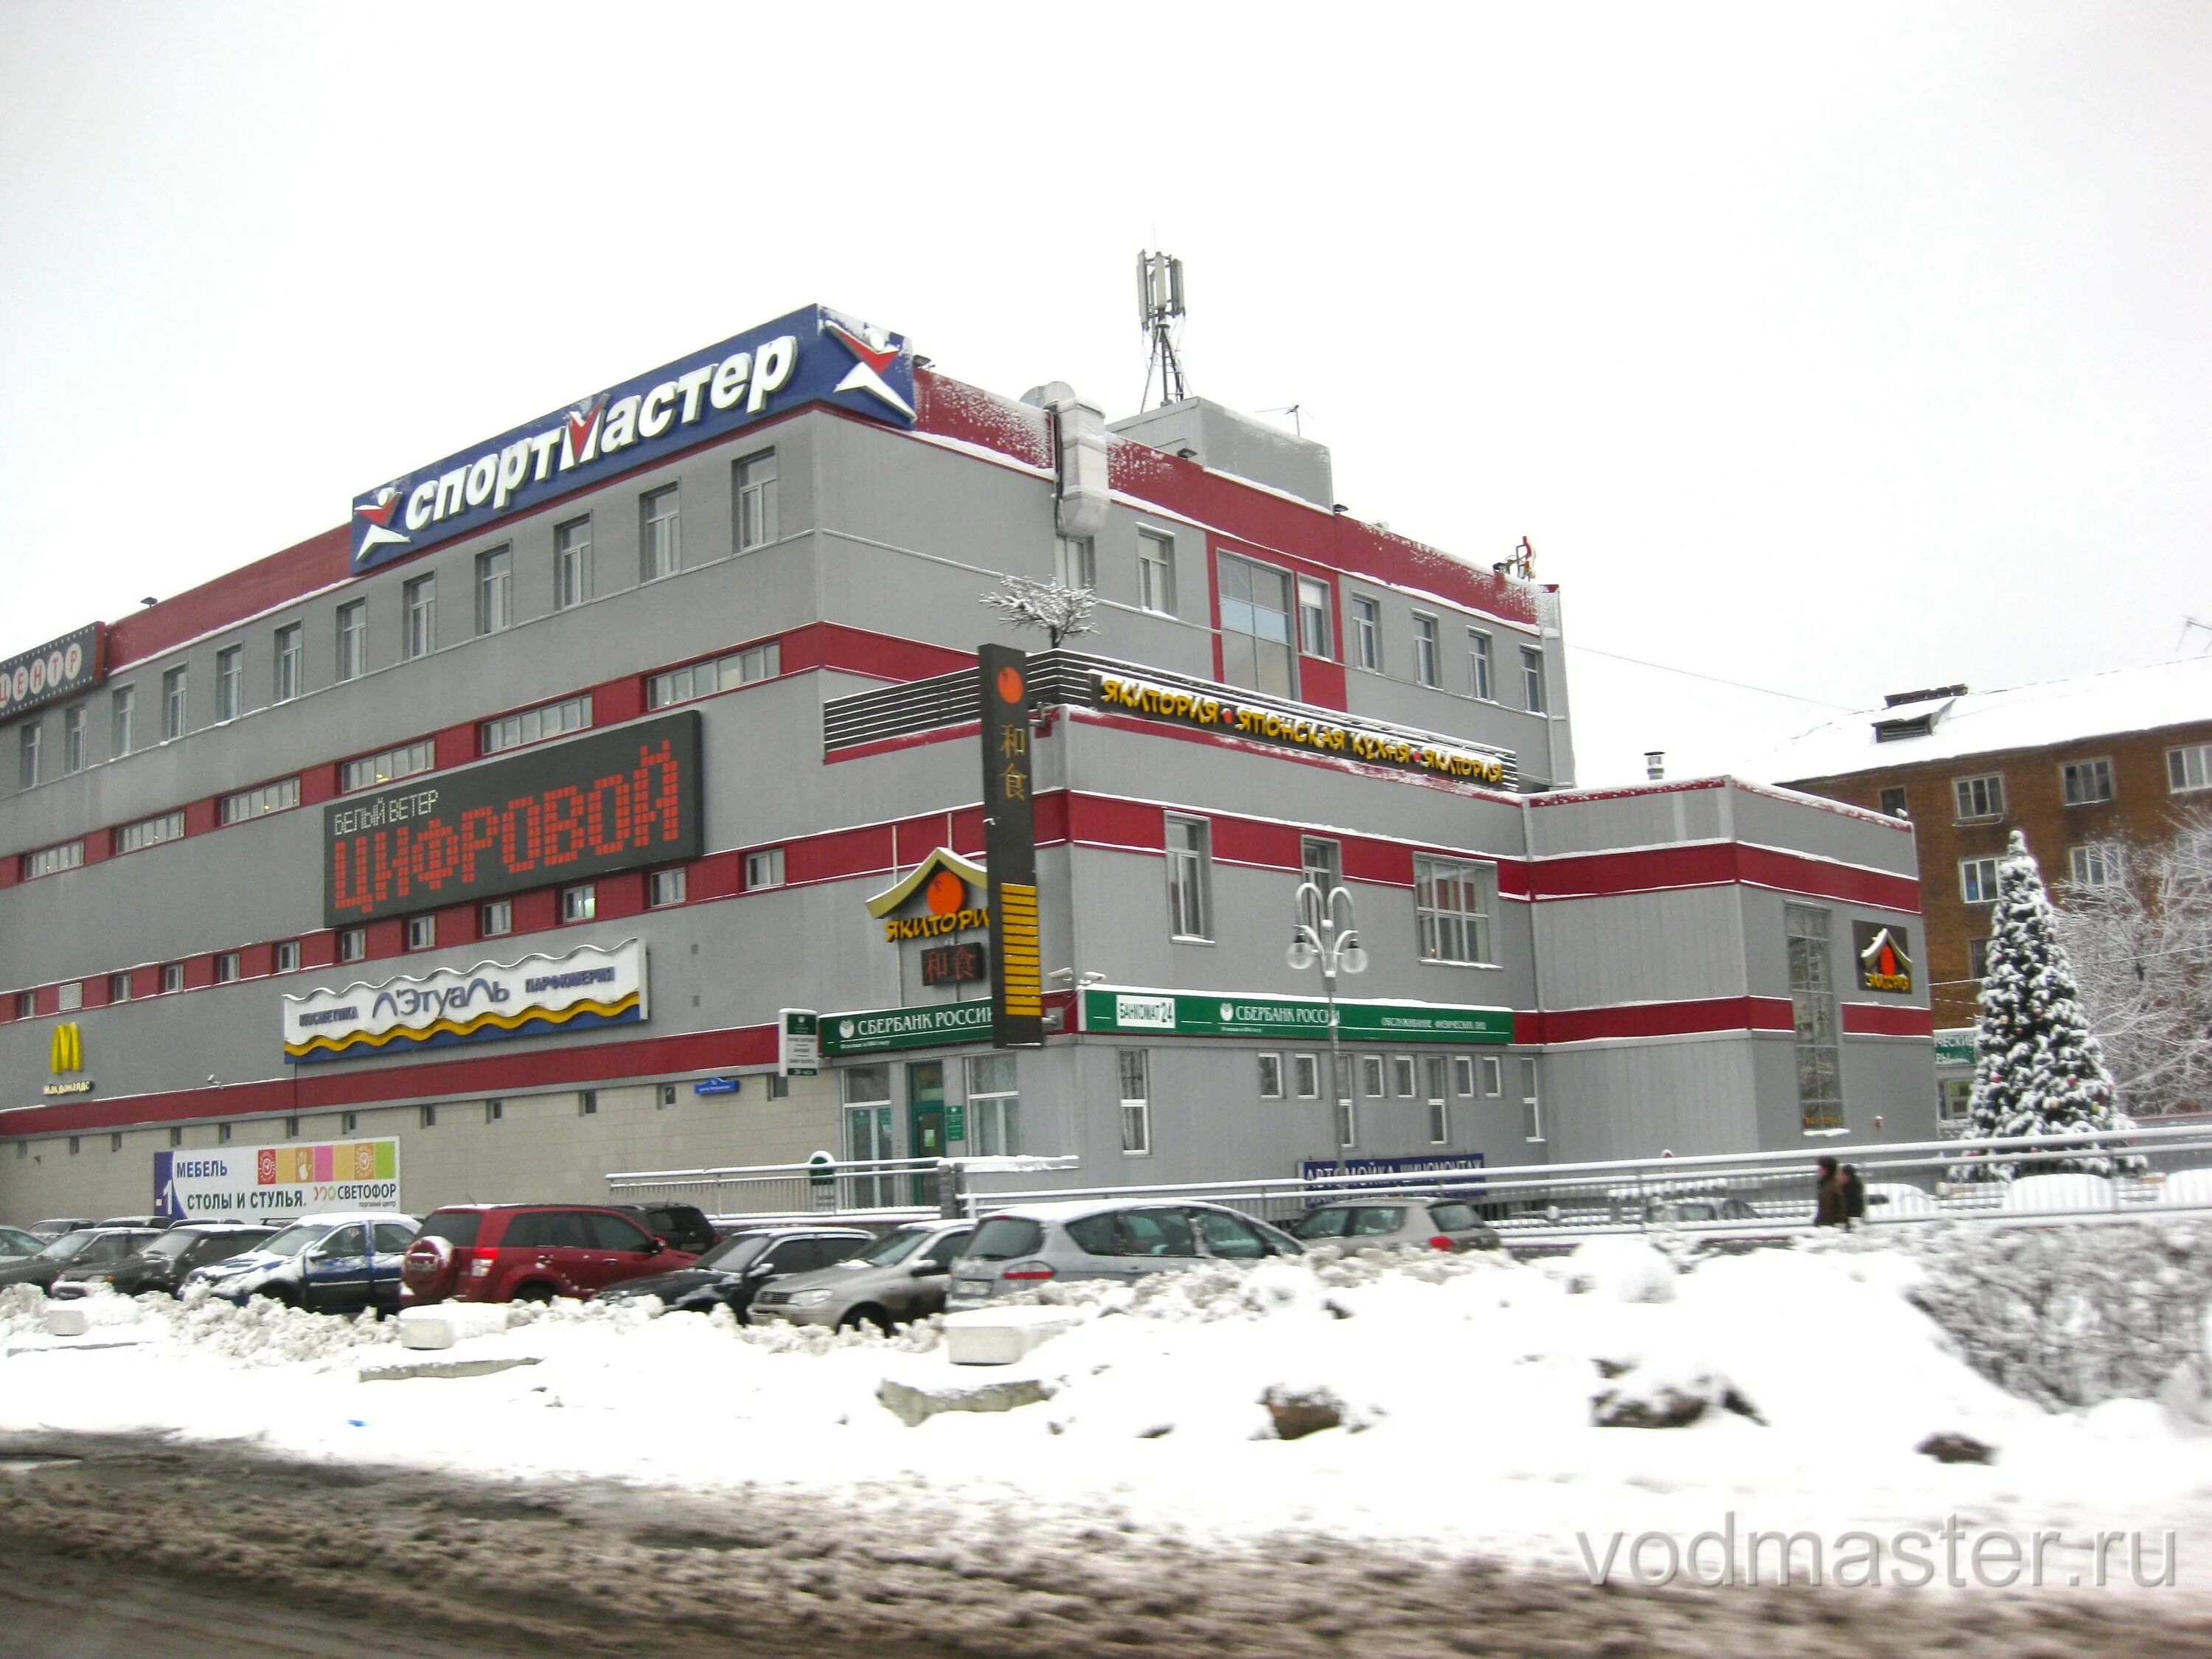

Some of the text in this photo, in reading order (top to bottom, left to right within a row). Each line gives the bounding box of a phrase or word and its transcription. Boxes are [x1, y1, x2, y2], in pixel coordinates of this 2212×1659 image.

[1103, 679, 1503, 783] ЯКИТОРИЯ ЯПОНСКАЯ КУХНЯ ЯКИТОРИЯ
[335, 789, 439, 835] БЕЛЫЙ ВЕТЕР
[335, 740, 678, 913] ЦИФРОВОЙ
[885, 908, 990, 942] ЯКИТОРИ
[858, 1013, 933, 1035] СБЕРБАНК
[1235, 1006, 1295, 1022] СБЕРБАНК
[177, 1160, 227, 1178] МЕБЕЛЬ
[187, 1190, 232, 1210] СТОЛЫ
[237, 1191, 246, 1208] И
[338, 1183, 397, 1200] СВЕТОФОР
